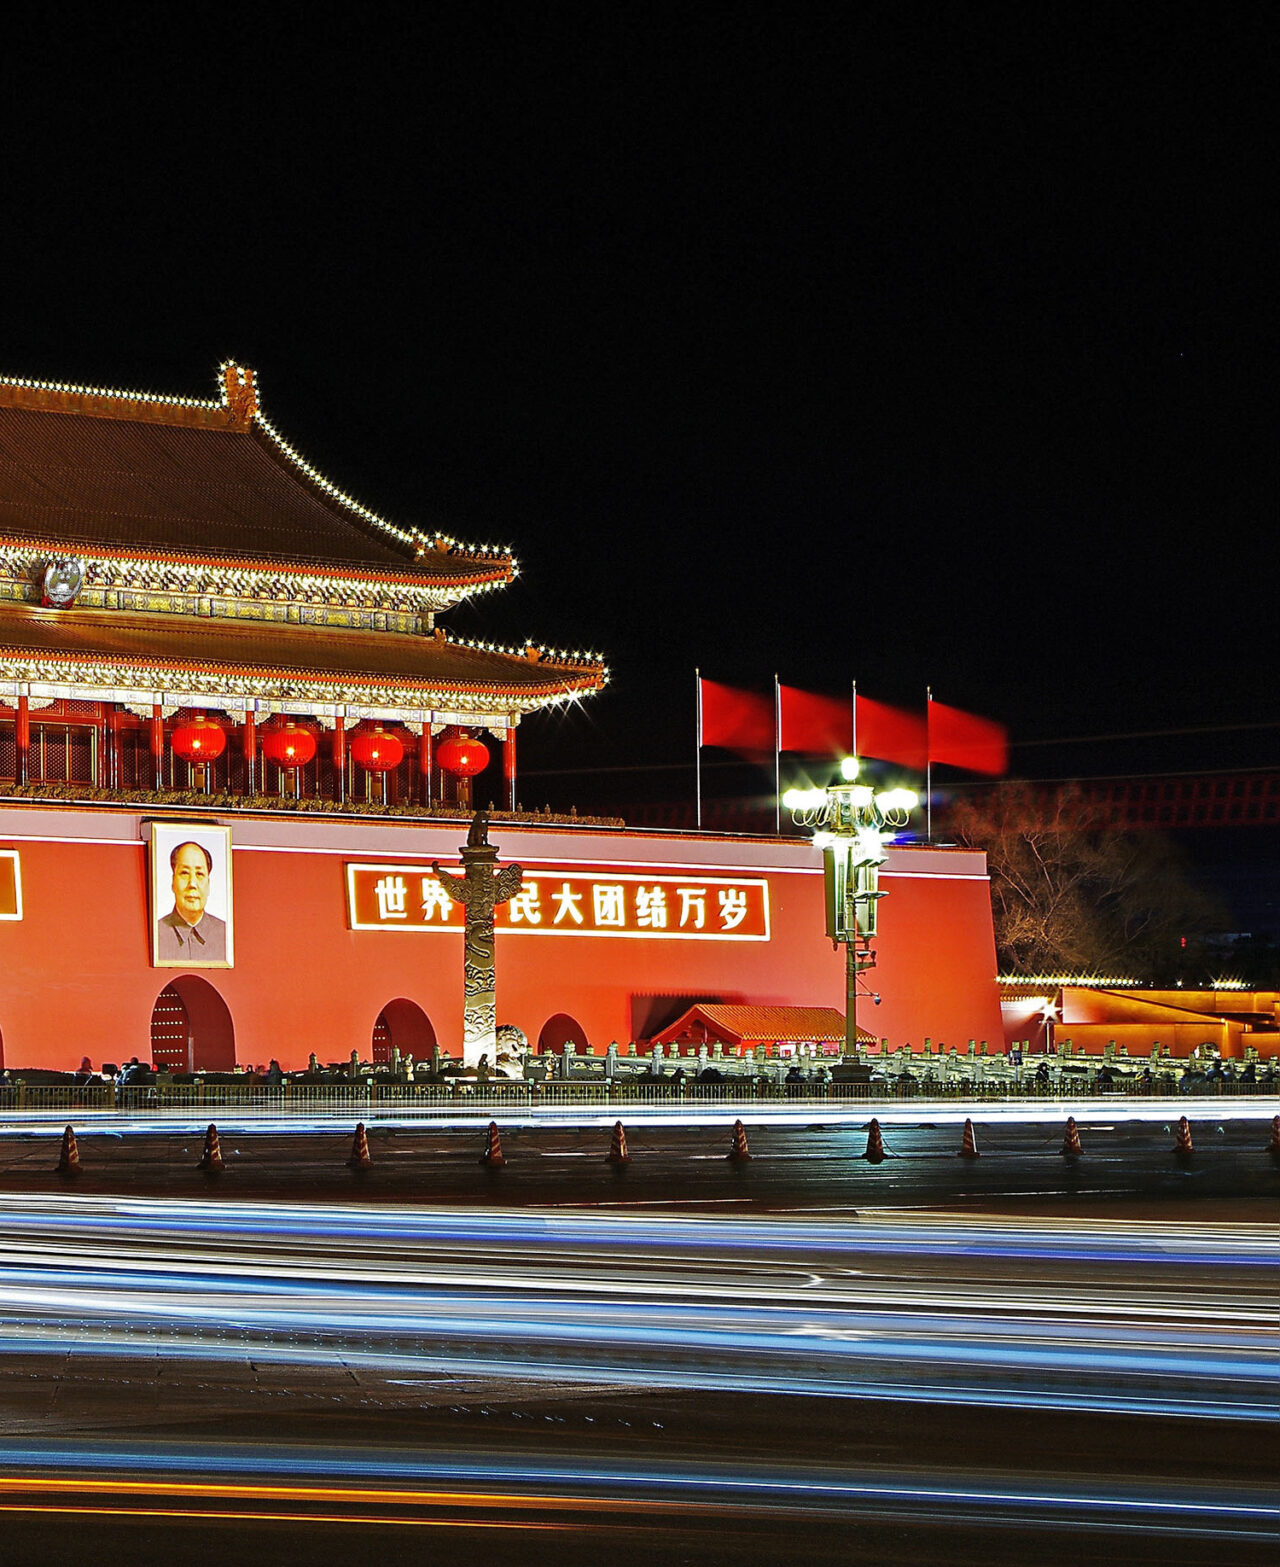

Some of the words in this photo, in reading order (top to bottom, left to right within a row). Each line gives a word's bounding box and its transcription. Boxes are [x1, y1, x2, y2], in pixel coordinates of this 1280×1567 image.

[374, 875, 748, 930] 世界民大团结万岁
